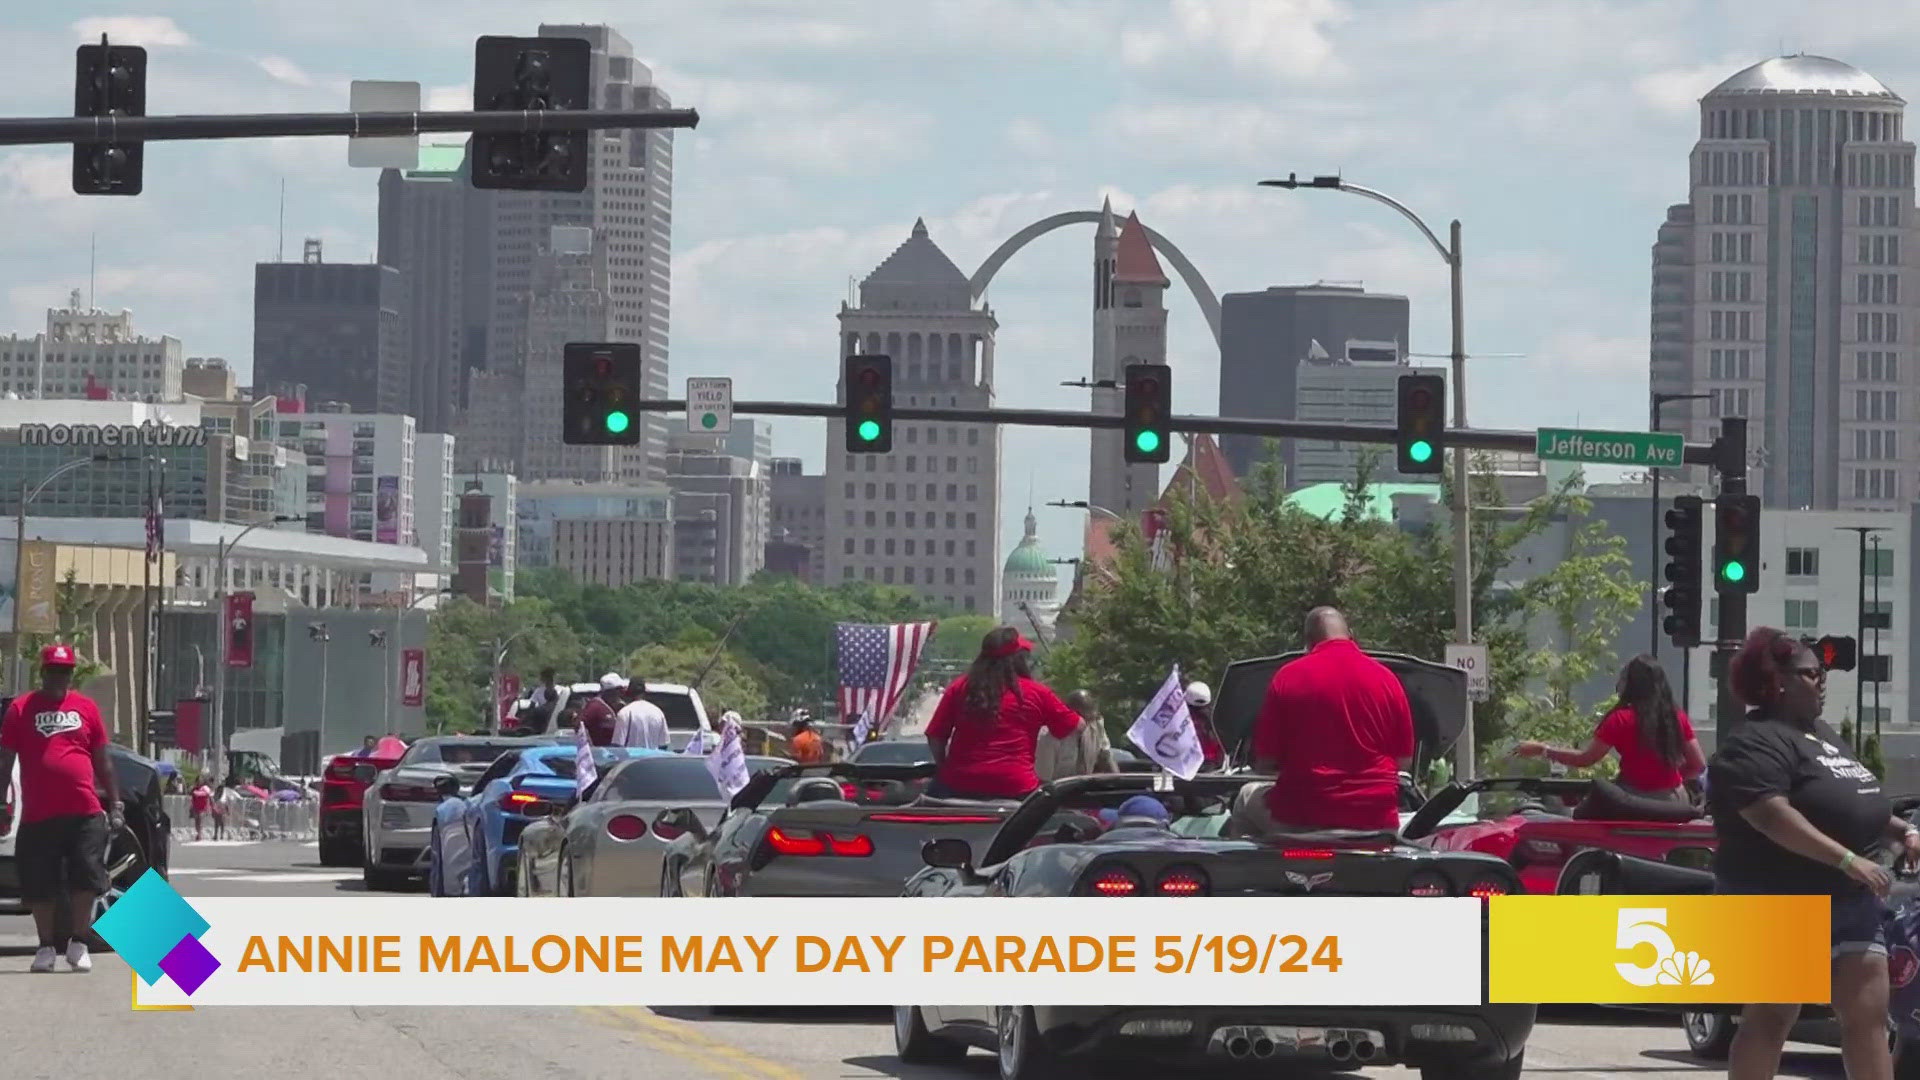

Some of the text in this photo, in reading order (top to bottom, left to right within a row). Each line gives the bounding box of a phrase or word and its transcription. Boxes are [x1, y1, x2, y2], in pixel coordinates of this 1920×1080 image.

[697, 391, 723, 401] YIELD
[20, 419, 207, 446] momentum
[1546, 435, 1675, 461] Jefferson Ave
[1456, 657, 1475, 669] NO
